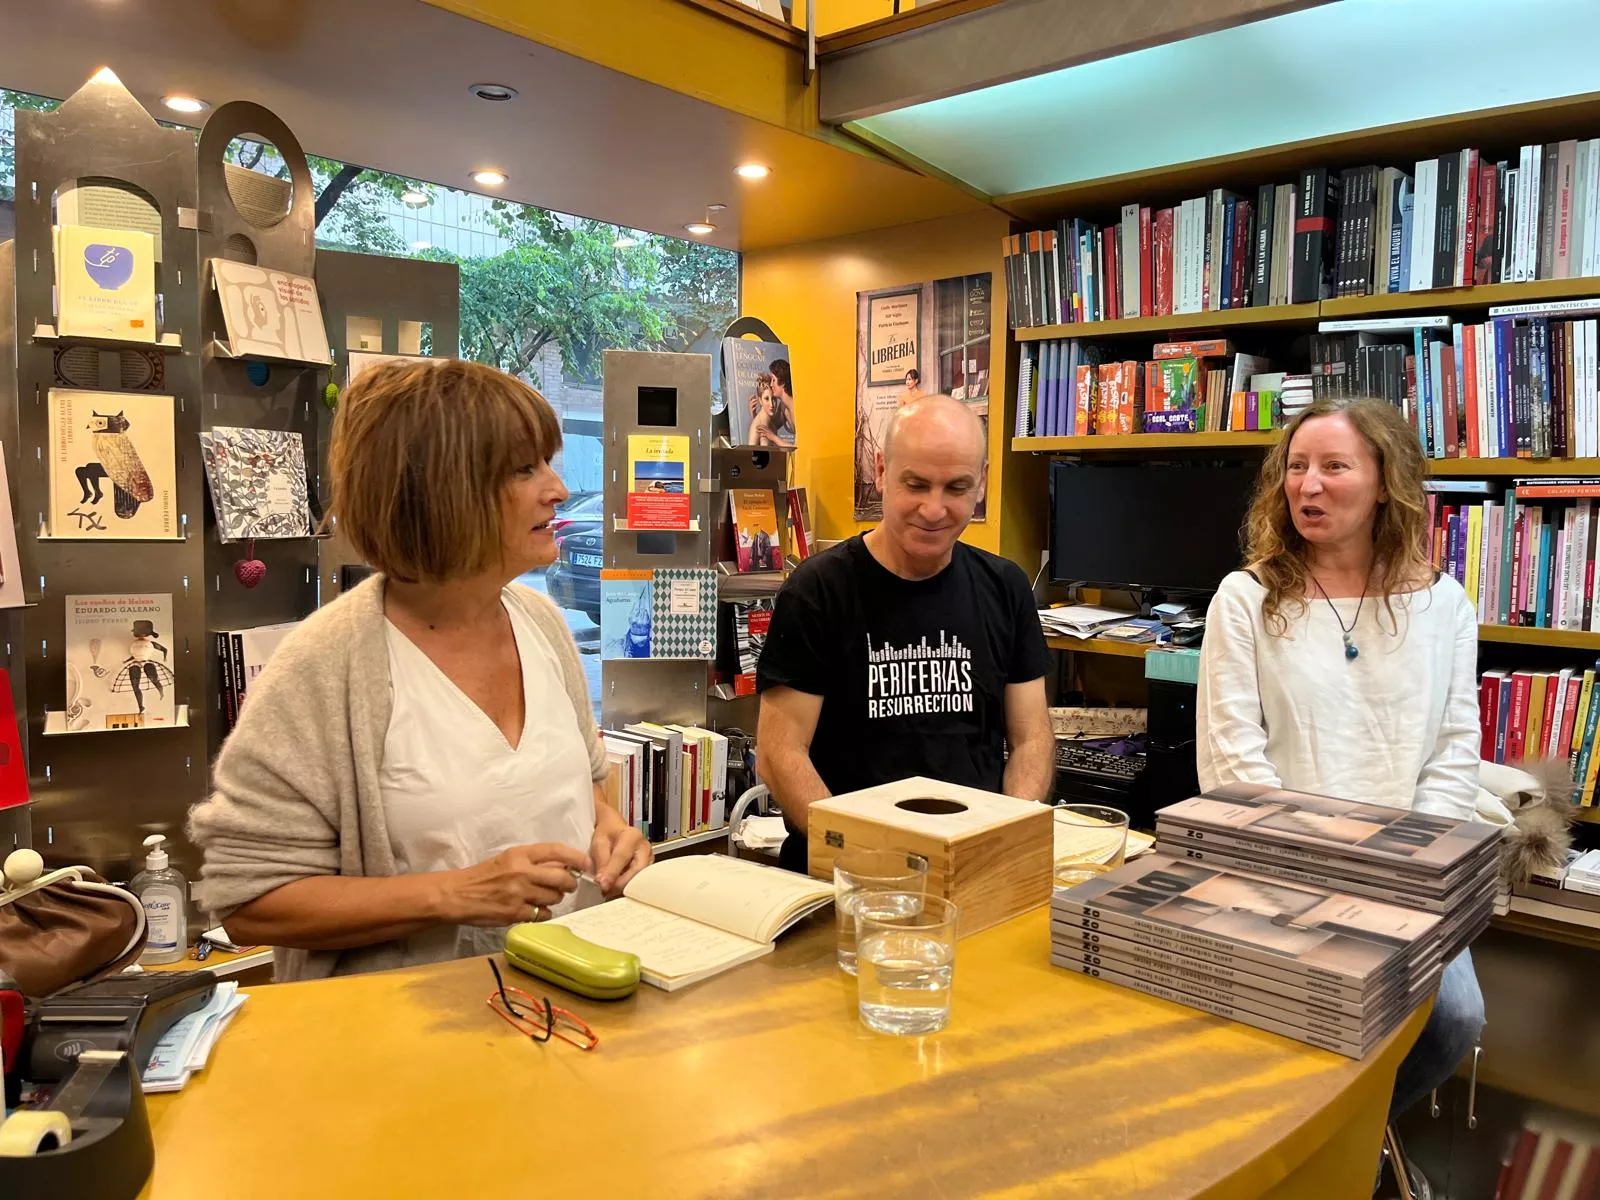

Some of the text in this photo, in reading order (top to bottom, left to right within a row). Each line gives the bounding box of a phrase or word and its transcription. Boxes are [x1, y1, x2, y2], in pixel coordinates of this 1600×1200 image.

[1390, 230, 1401, 282] ¡VIVA EL MAQUIS!
[872, 338, 915, 365] LIBRERÍA
[577, 552, 592, 564] 7524
[868, 660, 972, 698] PERIFERIAS
[869, 694, 973, 718] RESURRECTION
[1187, 830, 1204, 840] NO
[1187, 850, 1204, 859] NO
[1105, 870, 1192, 908] NO
[1083, 907, 1100, 918] NO
[1082, 918, 1099, 929] NO
[1082, 932, 1100, 942] NO
[1083, 941, 1100, 952] NO
[1084, 954, 1101, 964] NO
[1083, 966, 1100, 976] NO
